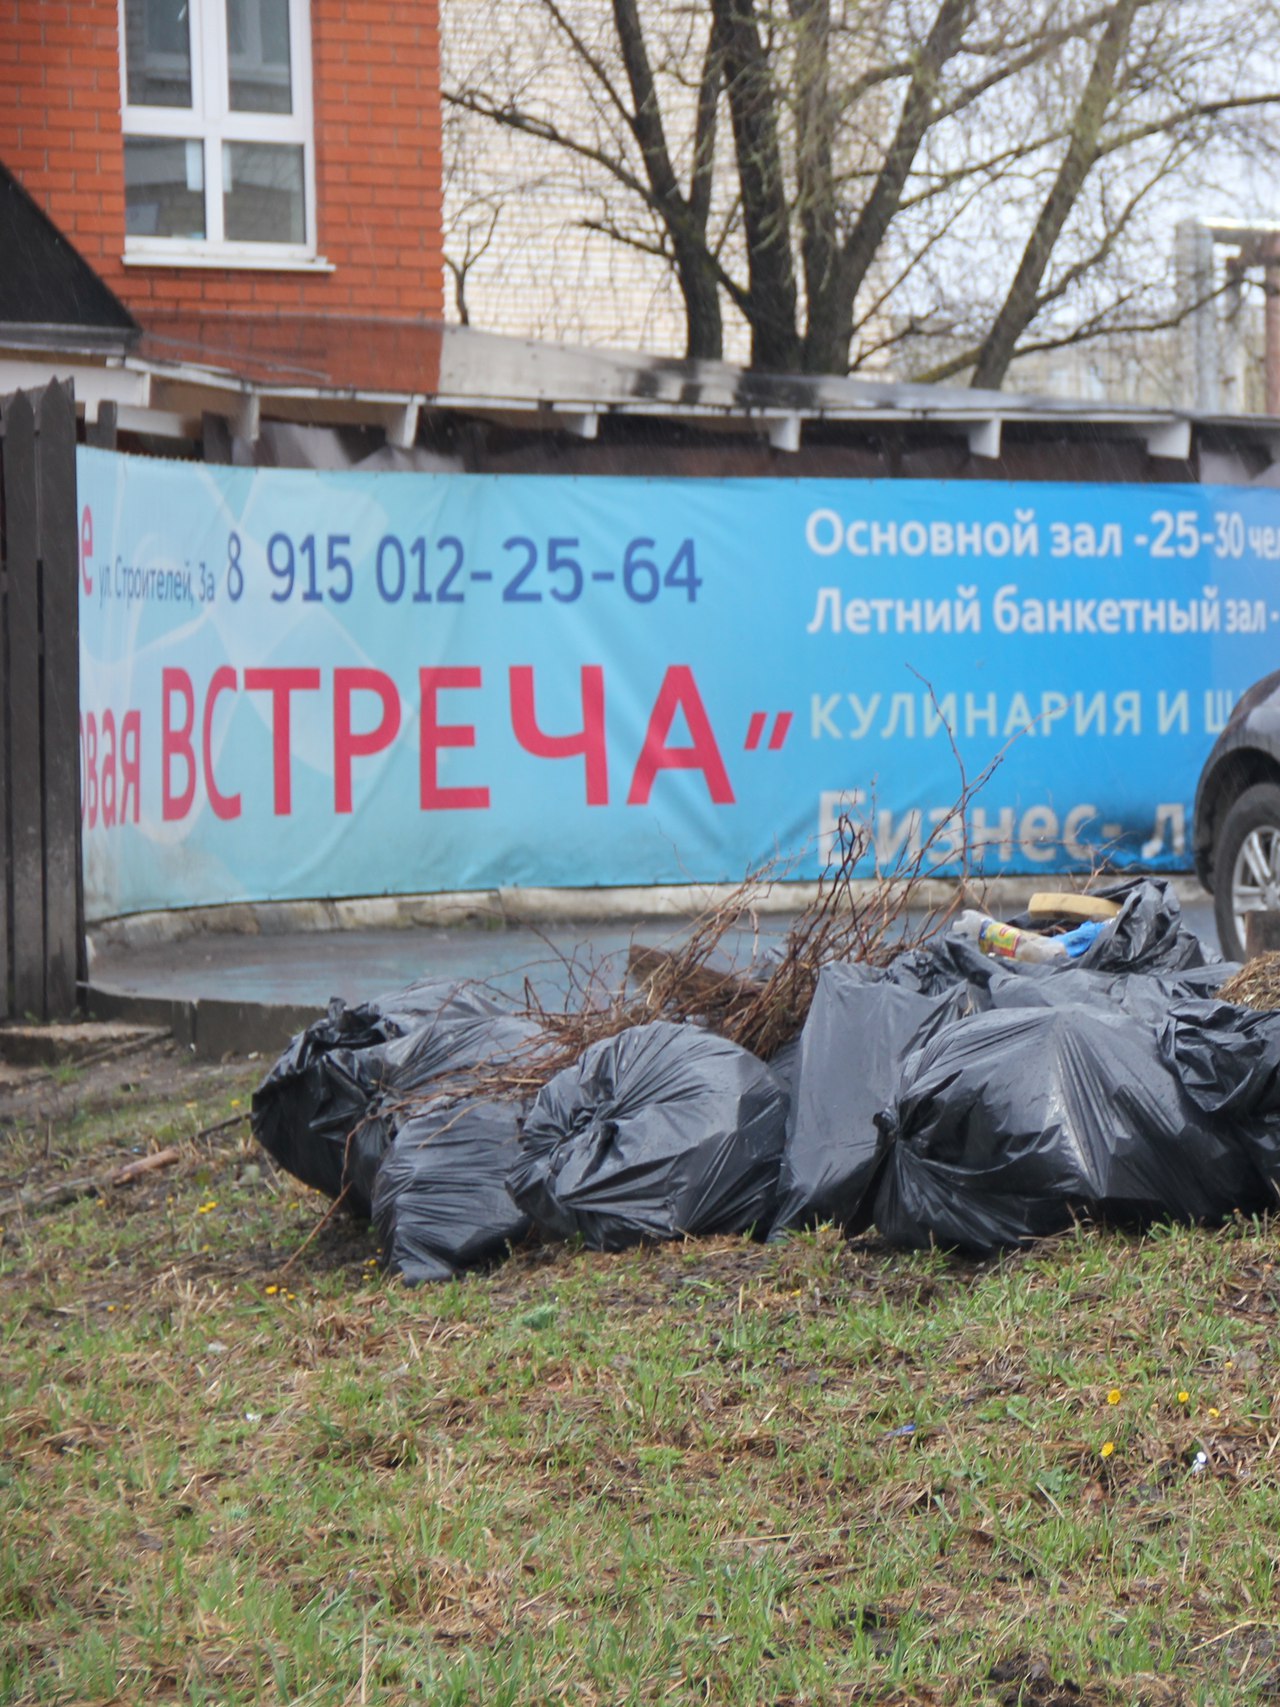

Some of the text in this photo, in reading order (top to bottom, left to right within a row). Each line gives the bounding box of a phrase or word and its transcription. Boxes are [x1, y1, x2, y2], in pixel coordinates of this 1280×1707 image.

[806, 508, 1038, 556] Основной
[1049, 521, 1122, 557] зал
[115, 554, 194, 608] Строителей,
[227, 530, 243, 603] 8
[267, 532, 353, 604] 915
[376, 535, 702, 604] 012-25-64
[807, 585, 981, 634] Летний
[993, 584, 1219, 634] банкетный
[1225, 598, 1266, 633] зал
[811, 690, 1245, 740] КУЛИНАРИЯ И Ш
